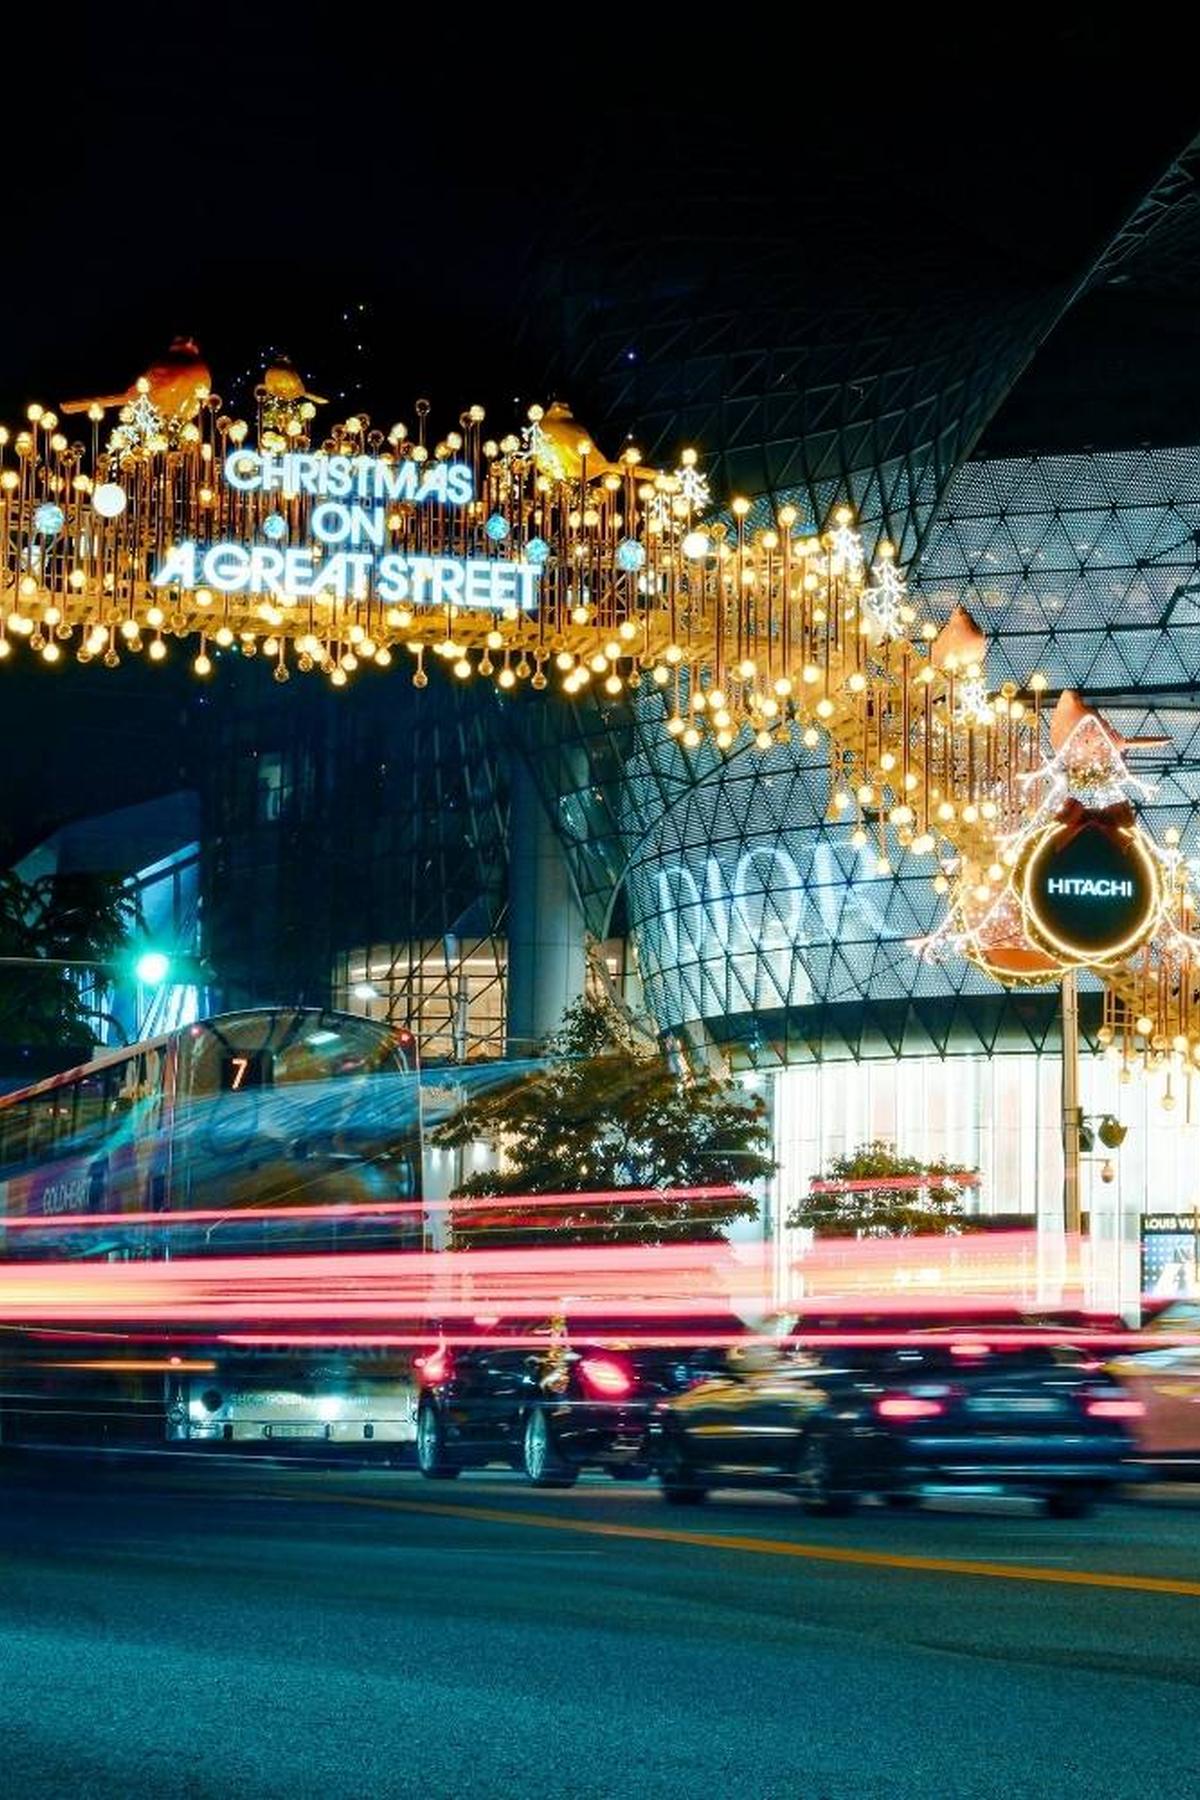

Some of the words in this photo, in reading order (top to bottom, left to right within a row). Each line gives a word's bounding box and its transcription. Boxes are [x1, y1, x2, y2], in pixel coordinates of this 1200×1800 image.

[223, 448, 474, 505] CHRISTMAS
[311, 502, 385, 546] ON
[153, 542, 197, 588] A
[203, 543, 375, 600] GREAT
[377, 556, 543, 610] STREET
[1047, 878, 1133, 897] HITACHI
[232, 1058, 248, 1089] 7
[1144, 1217, 1177, 1231] LOUIS
[1178, 1217, 1200, 1231] VU
